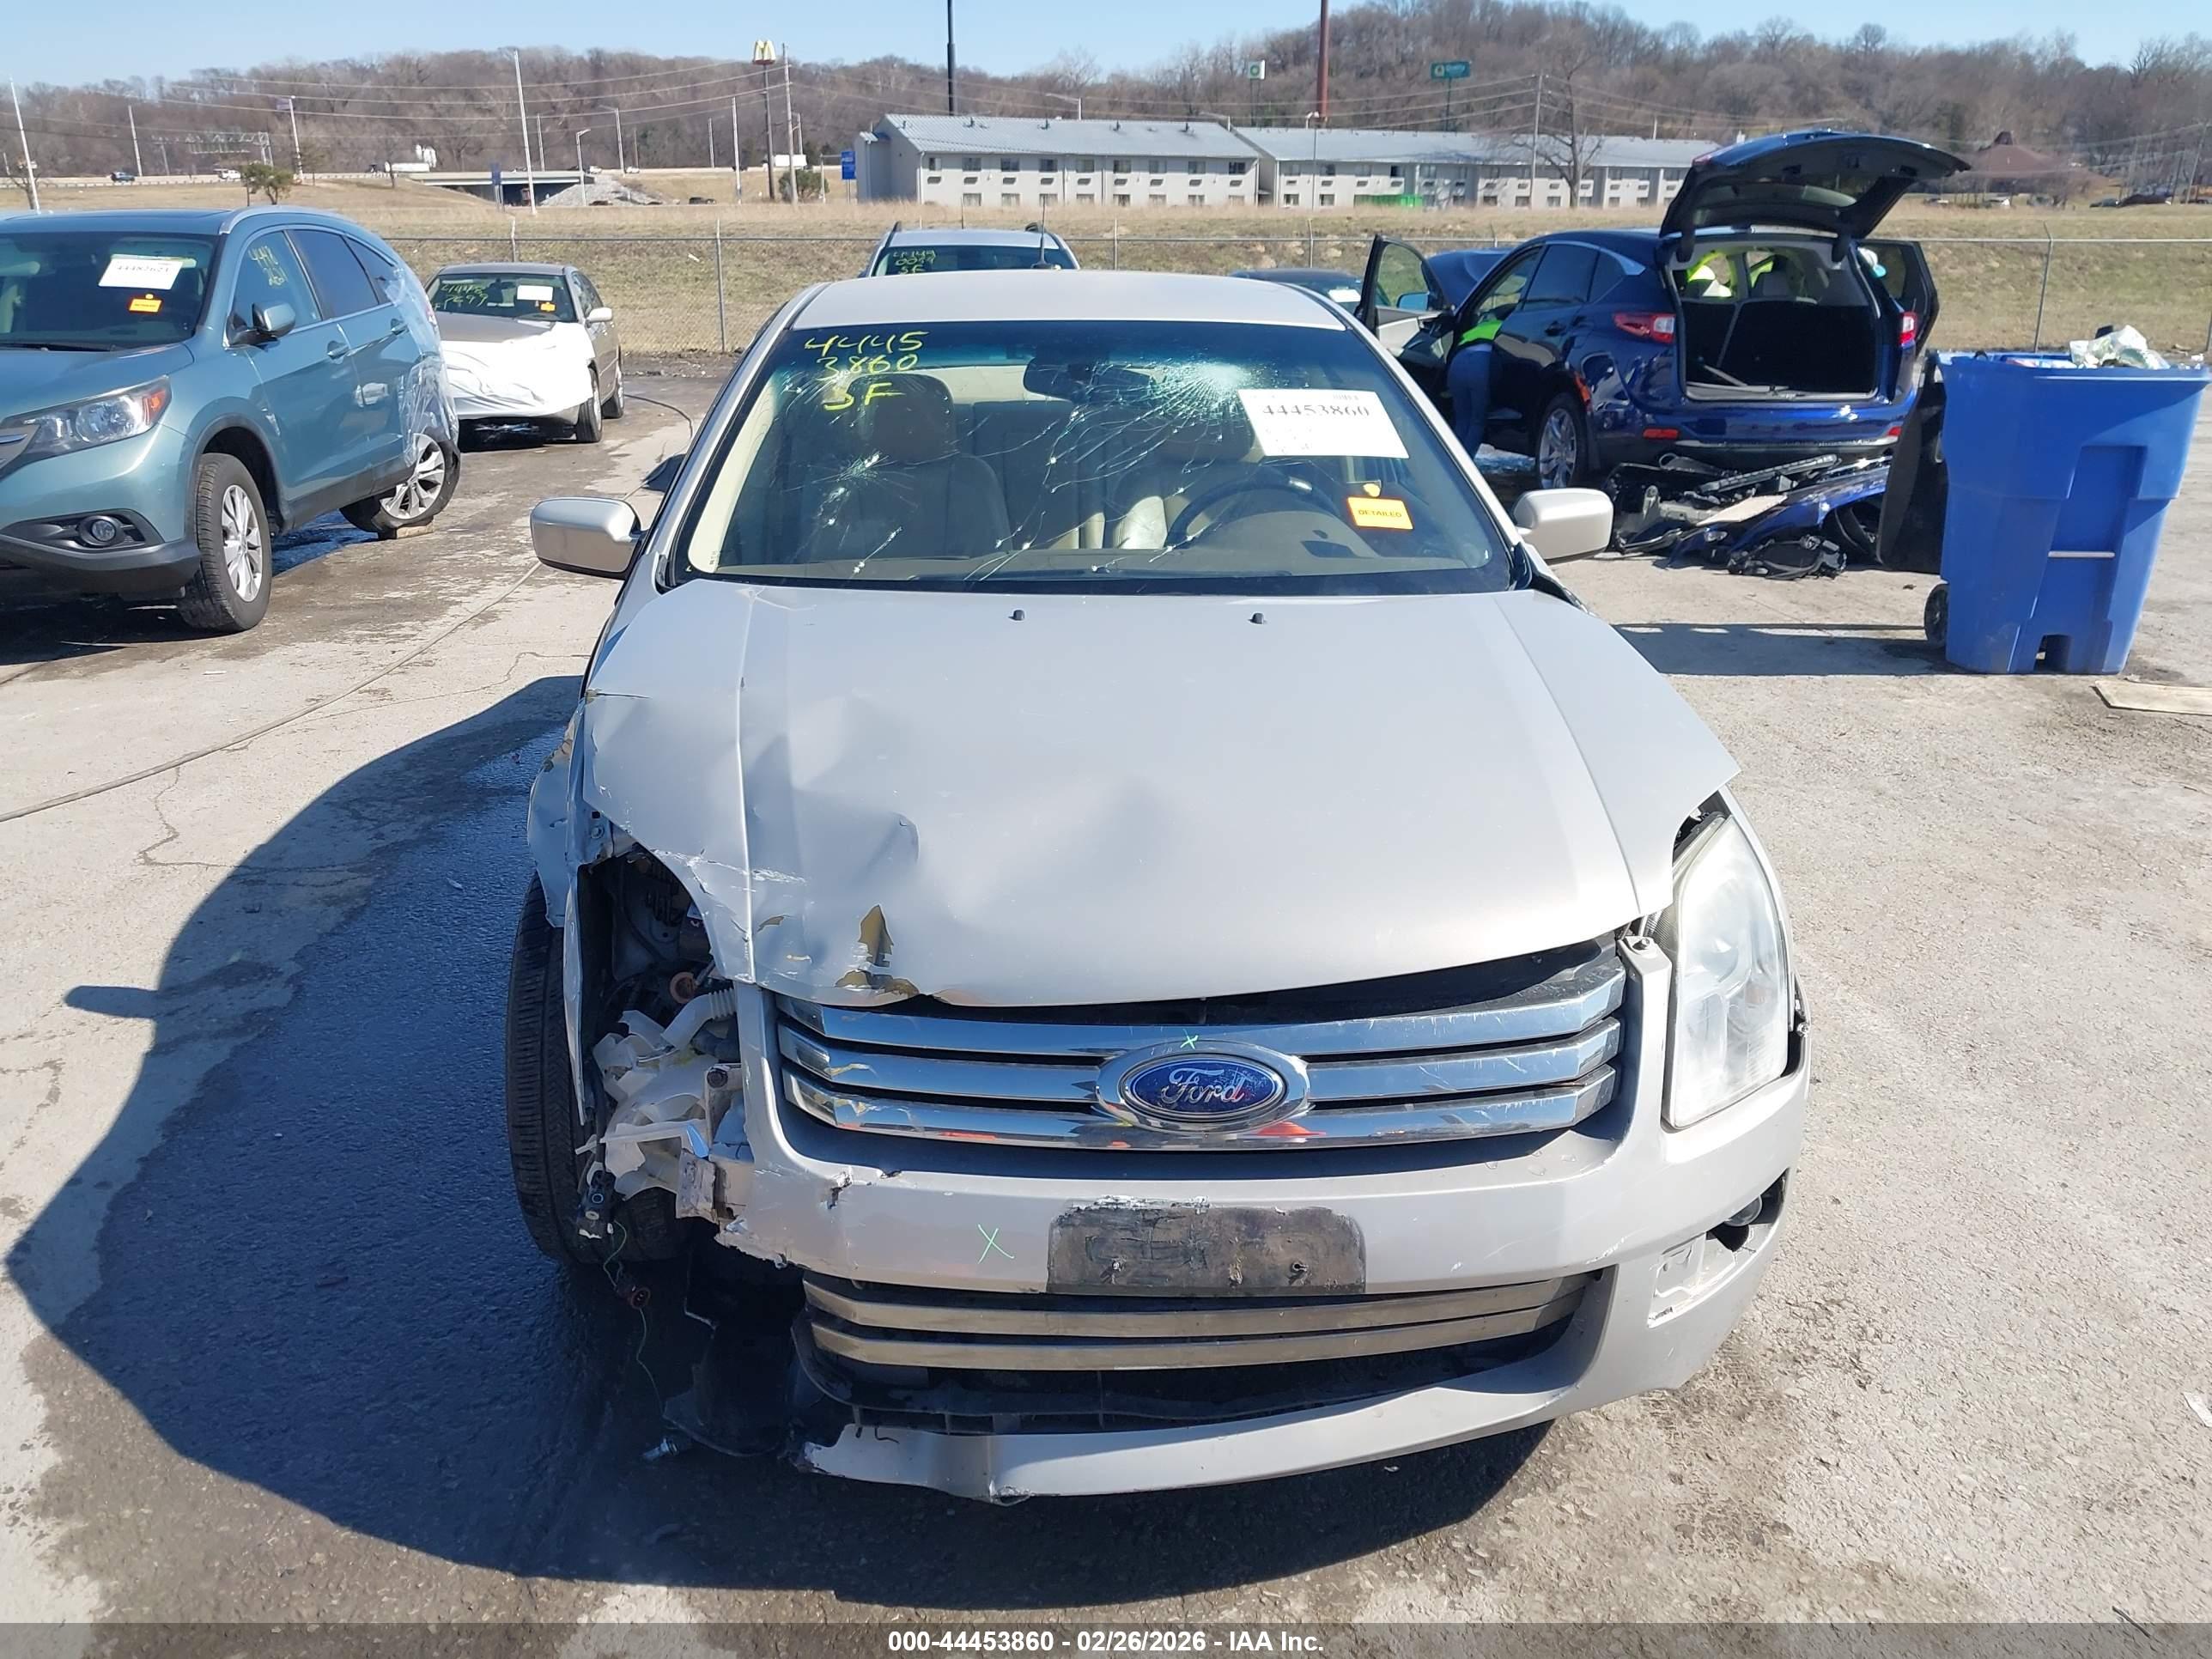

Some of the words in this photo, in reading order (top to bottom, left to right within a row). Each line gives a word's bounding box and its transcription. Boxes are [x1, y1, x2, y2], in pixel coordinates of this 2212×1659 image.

[805, 331, 929, 356] 4445
[816, 354, 918, 381] 3860
[1262, 404, 1370, 416] 44453860
[1161, 1067, 1245, 1103] Ford
